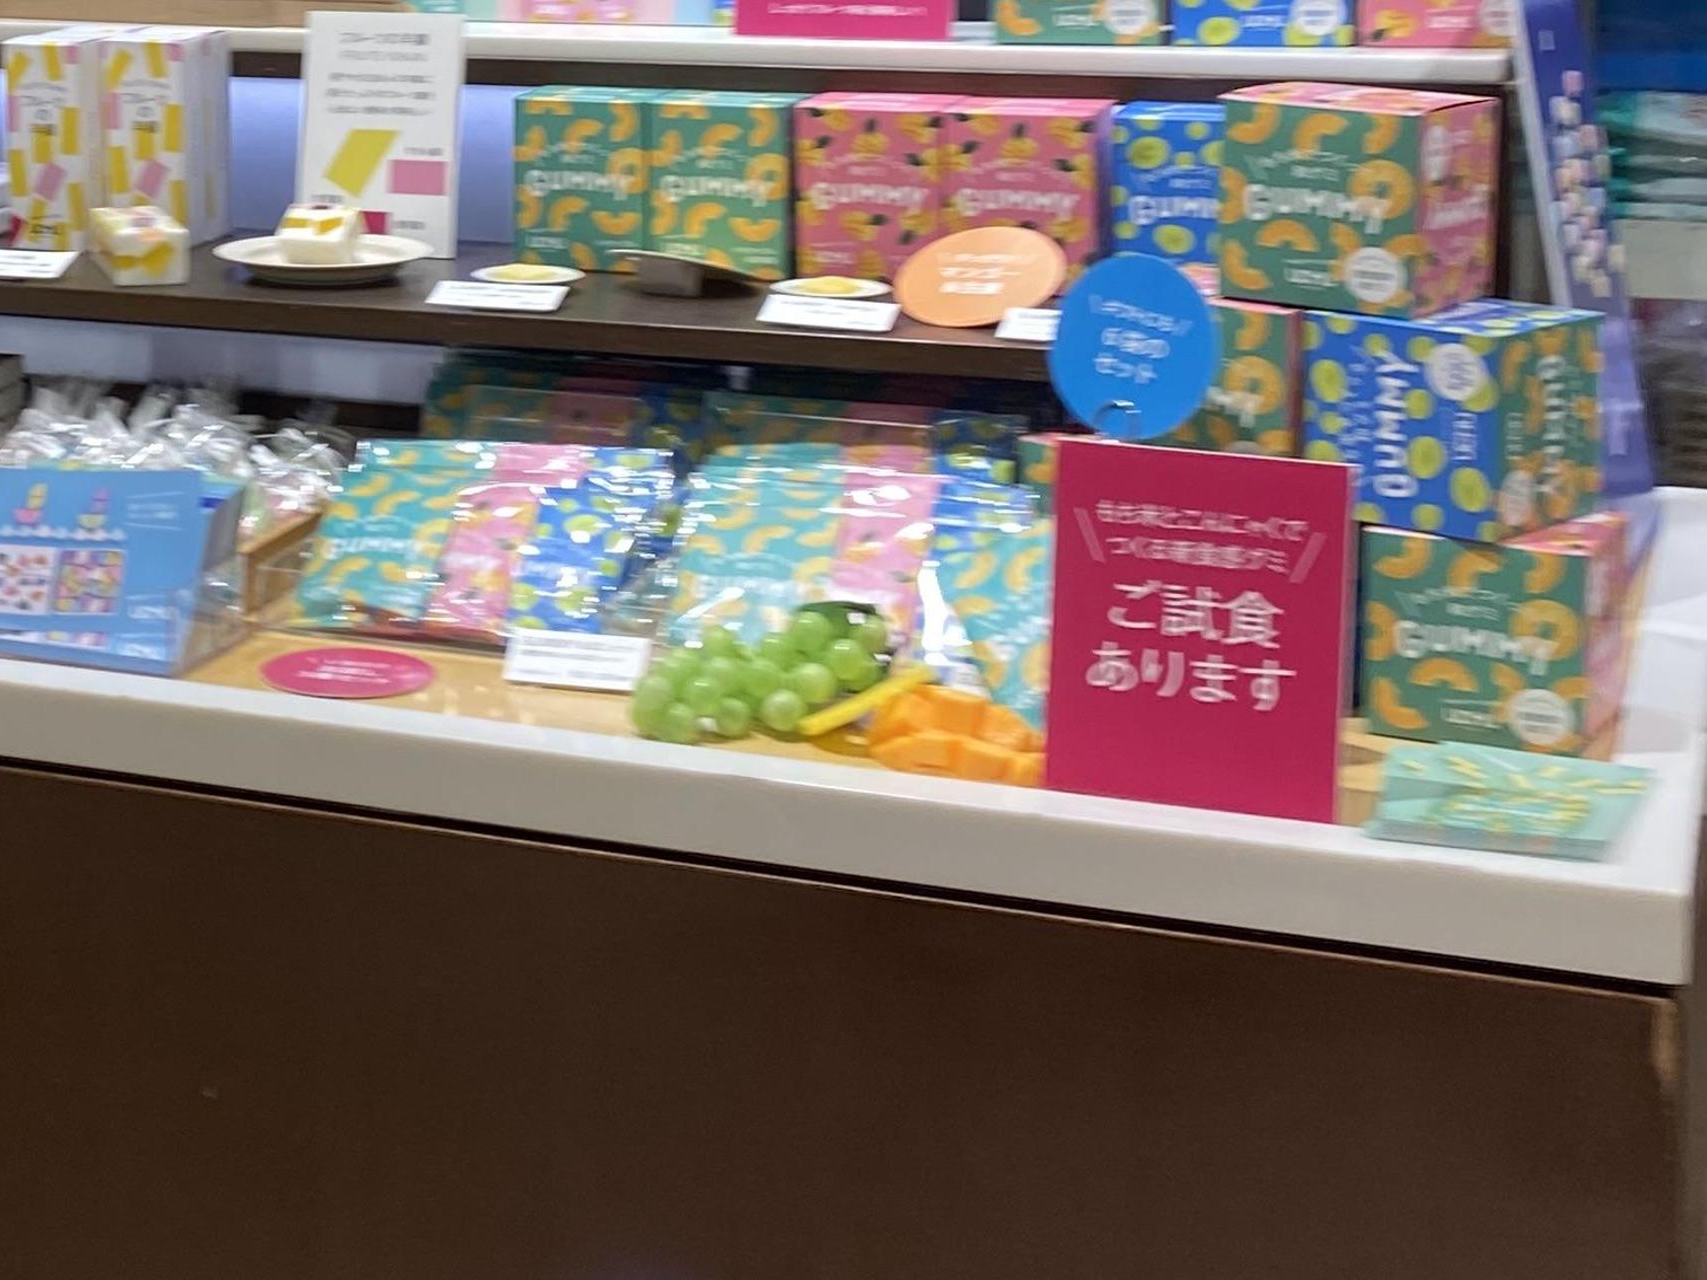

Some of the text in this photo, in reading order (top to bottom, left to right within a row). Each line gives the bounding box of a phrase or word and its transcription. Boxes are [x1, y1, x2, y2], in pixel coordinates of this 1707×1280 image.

[1244, 183, 1395, 235] GUMMY
[1107, 580, 1285, 648] ご試食
[1086, 641, 1297, 711] あります
[1396, 620, 1560, 676] GUMMY
